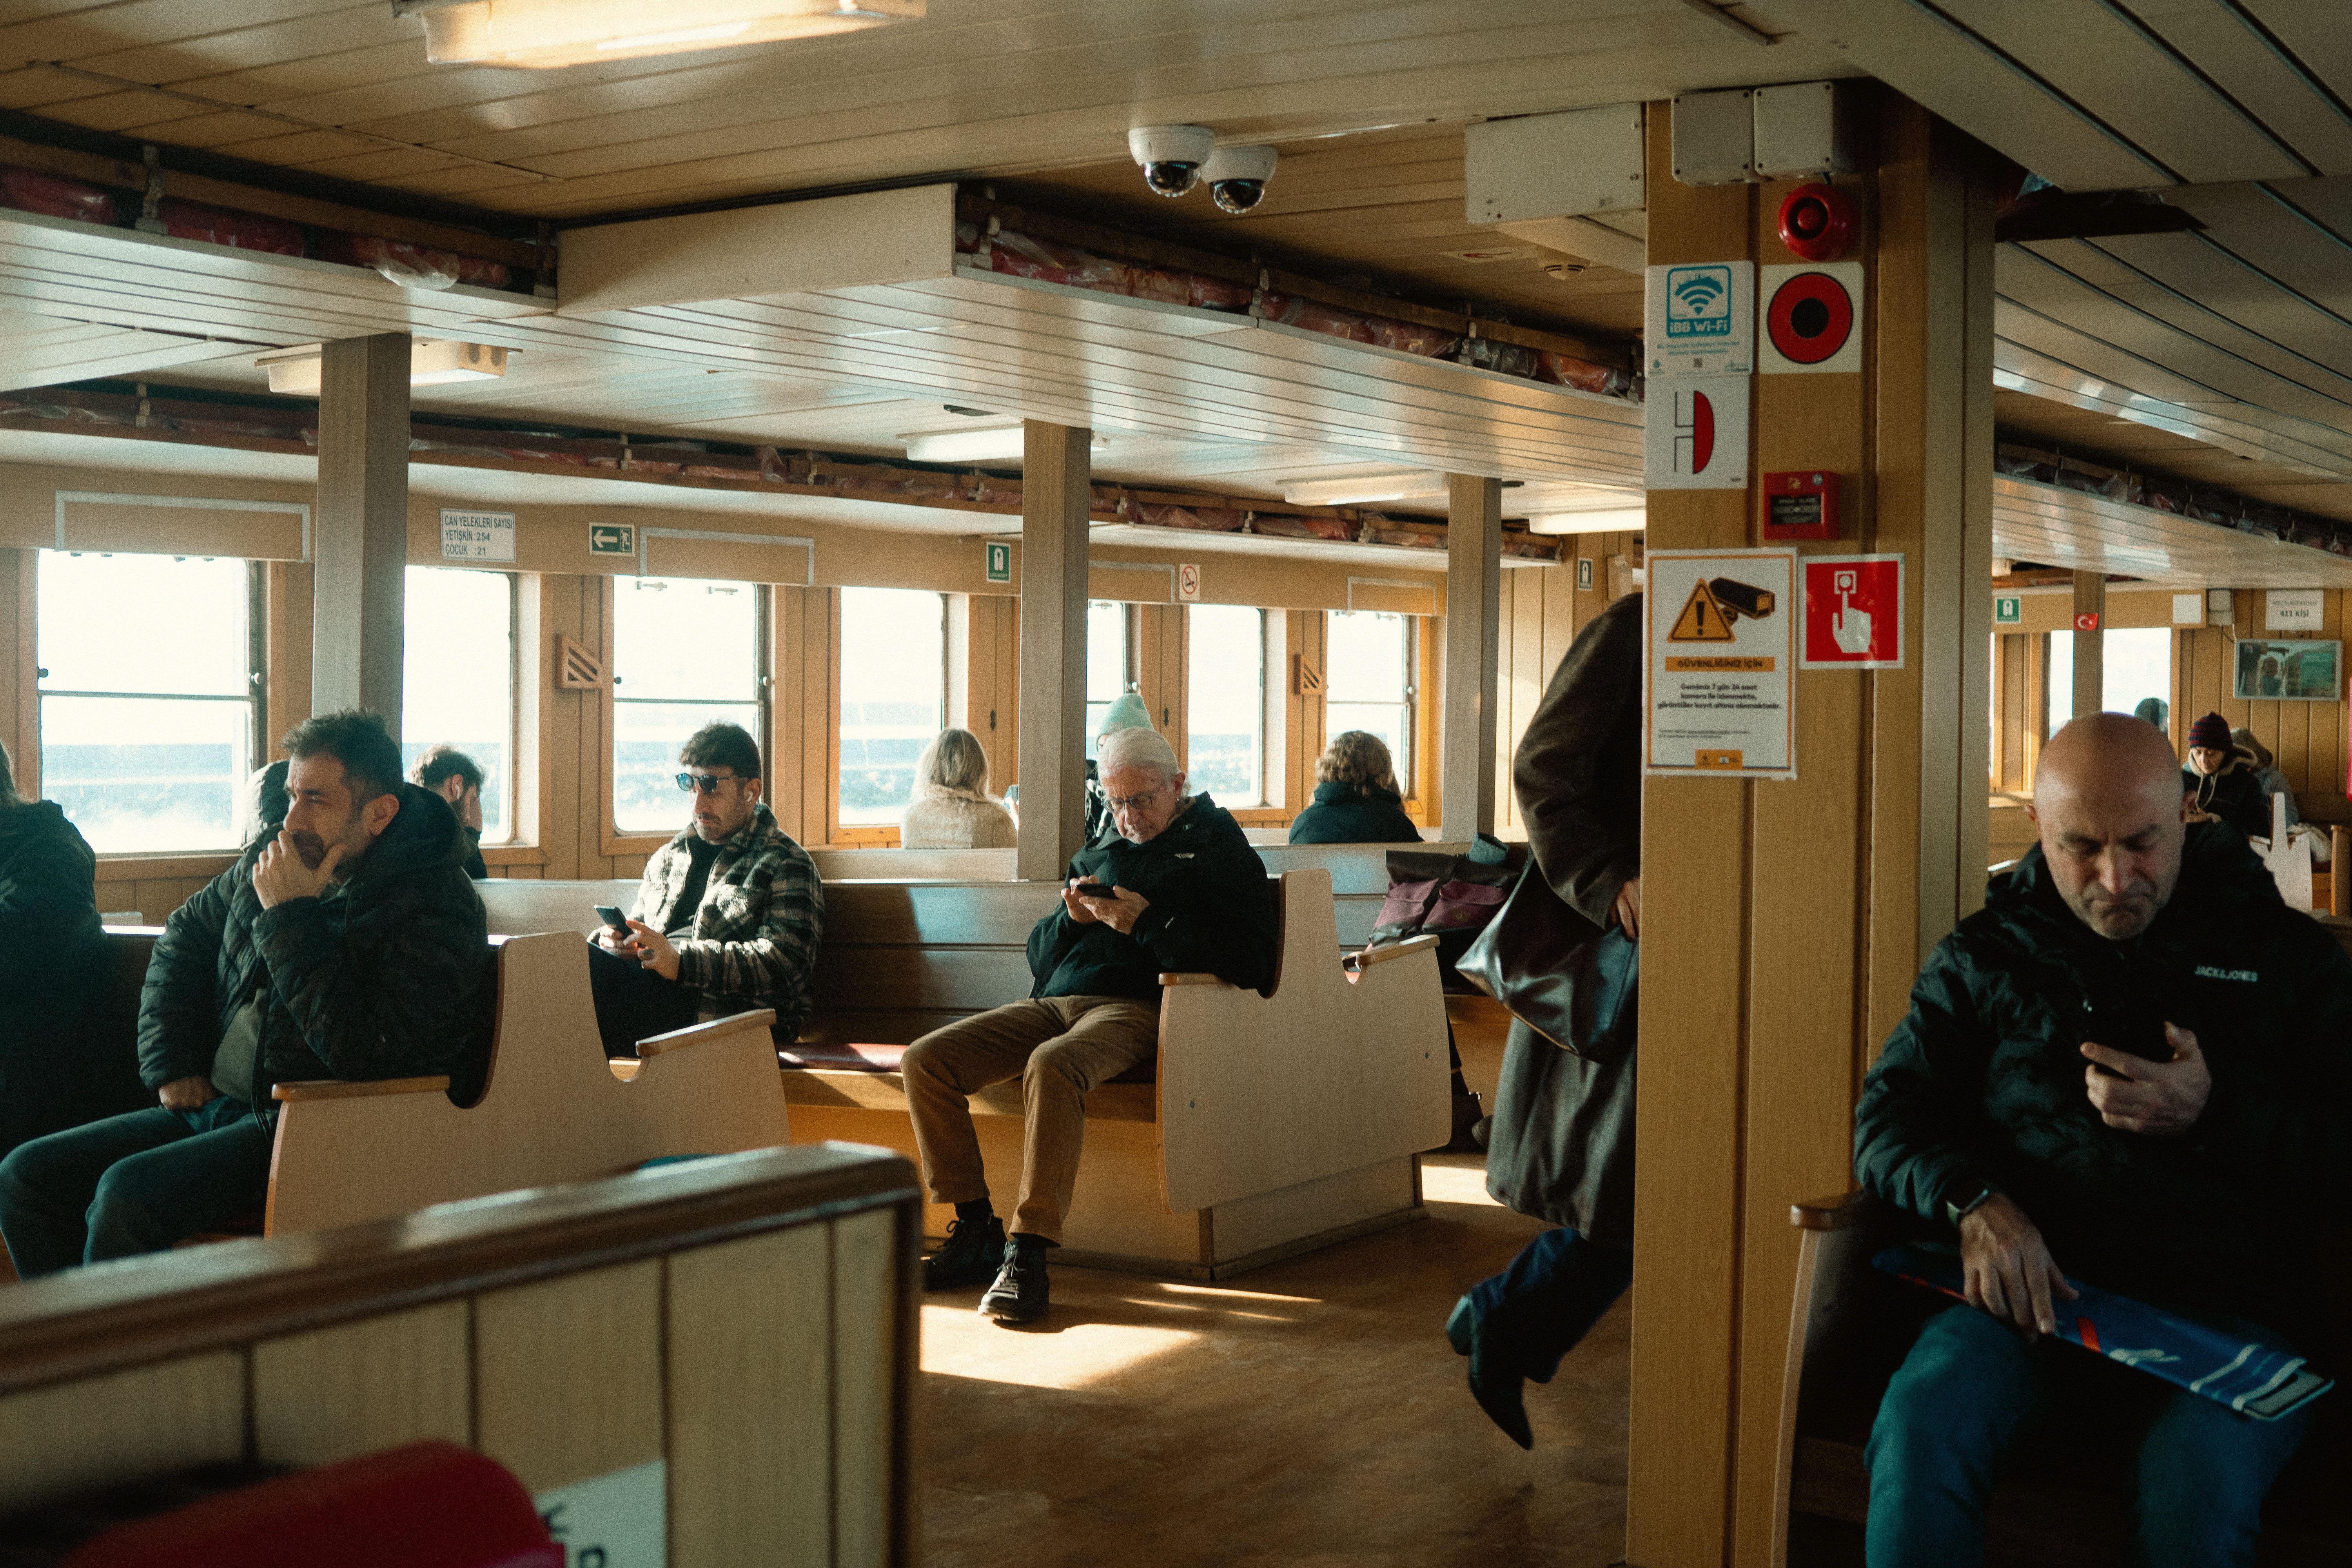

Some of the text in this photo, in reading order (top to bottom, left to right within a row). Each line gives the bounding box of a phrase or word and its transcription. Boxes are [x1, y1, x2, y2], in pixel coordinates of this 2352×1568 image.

[1693, 319, 1728, 332] Wi-Fi
[445, 515, 512, 529] CAN YELEKLERİ SAYISI
[445, 528, 473, 543] YETİŞKİN
[445, 543, 468, 558] ÇOCUK
[2296, 609, 2309, 618] KİŞİ
[1677, 658, 1763, 669] GÜVENLİĞİNİZ İÇİN
[1717, 684, 1730, 692] gün
